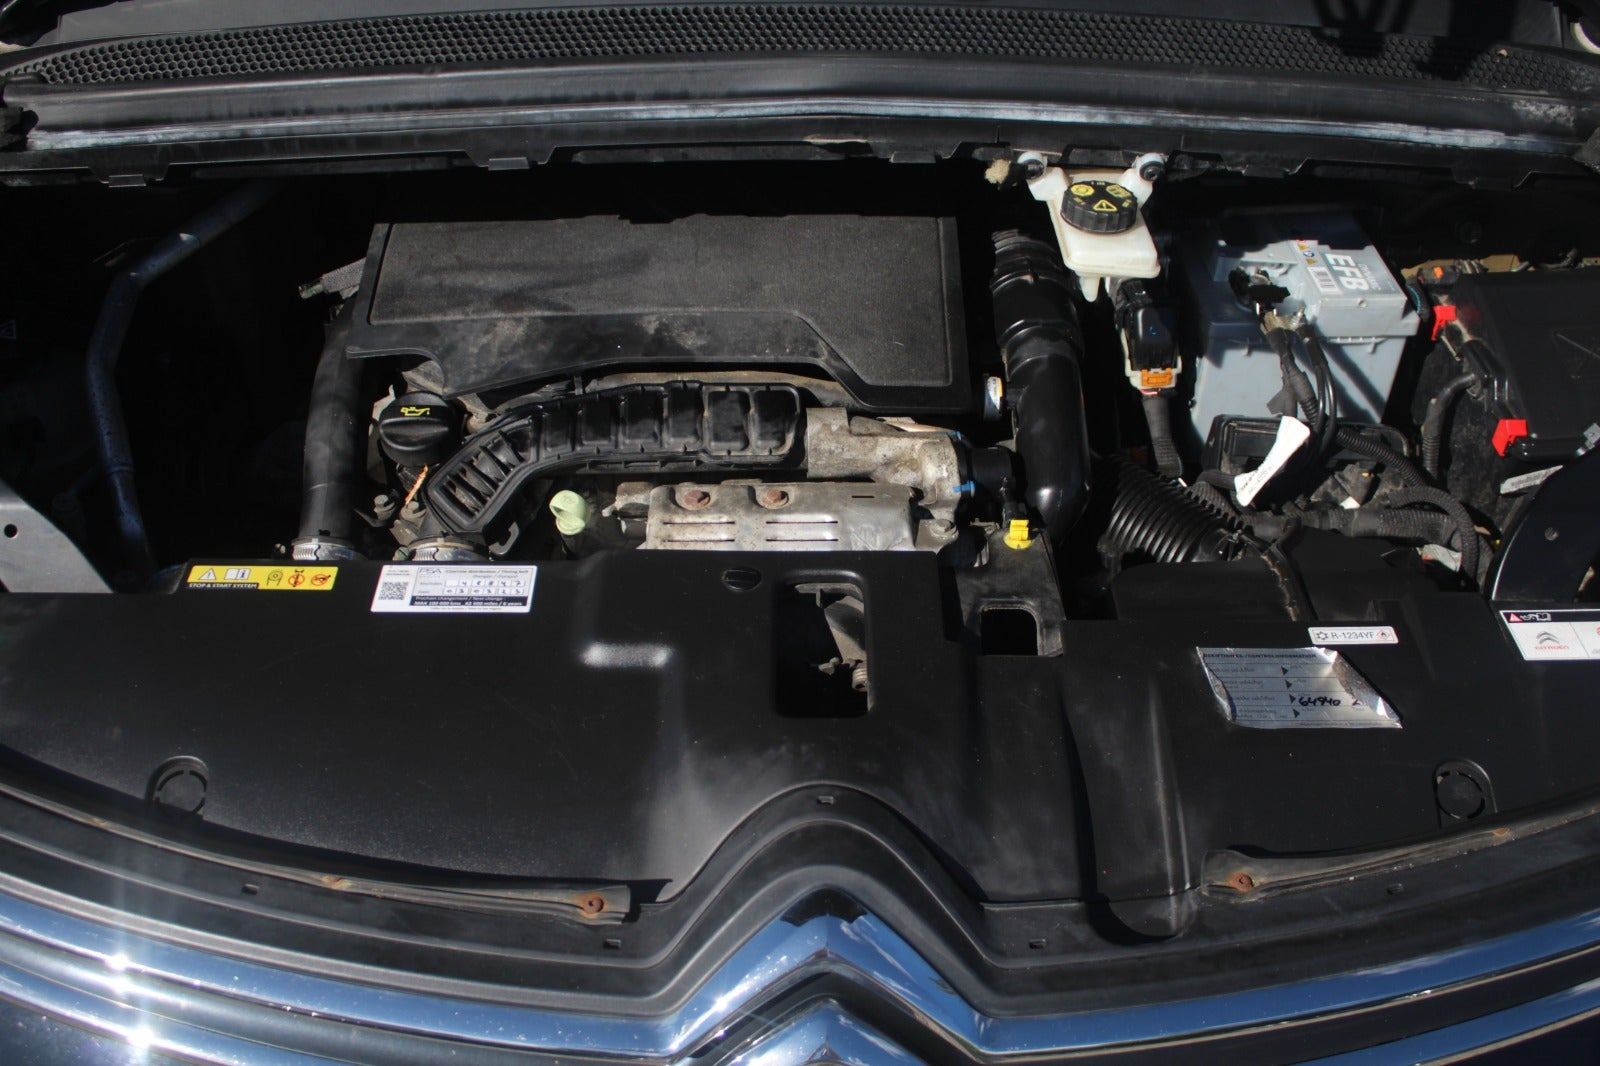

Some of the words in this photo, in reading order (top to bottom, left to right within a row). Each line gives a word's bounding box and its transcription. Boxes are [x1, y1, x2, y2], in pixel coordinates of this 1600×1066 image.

[1325, 253, 1370, 291] EFB
[1330, 631, 1375, 640] R-1234YF
[1298, 695, 1342, 707] 64940
